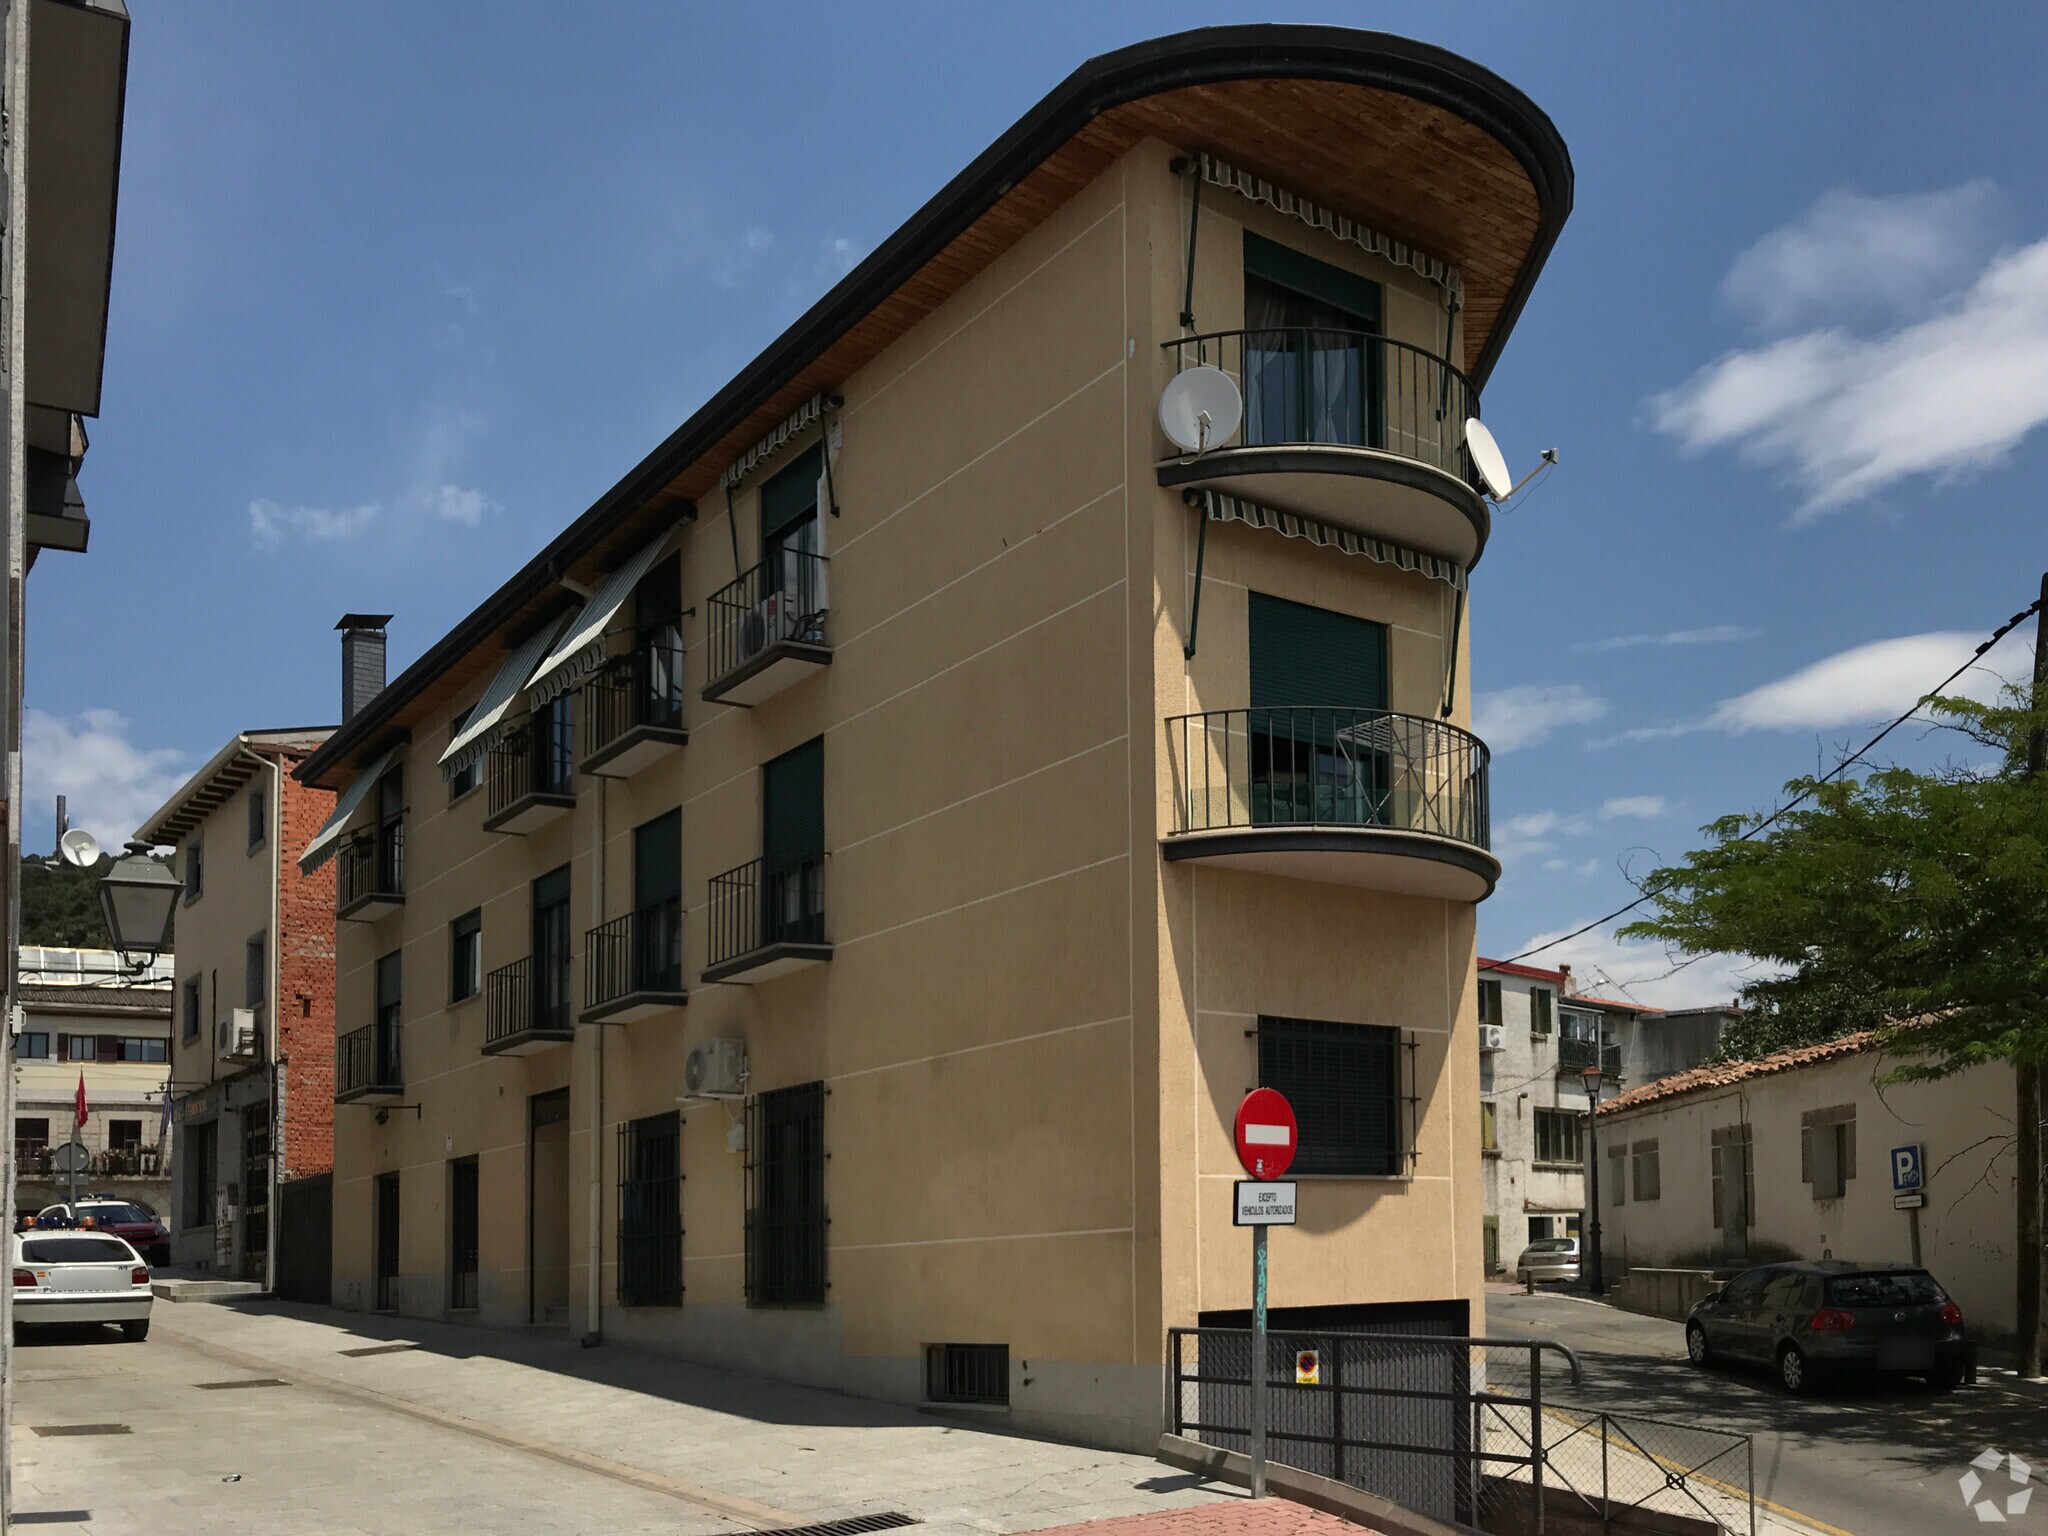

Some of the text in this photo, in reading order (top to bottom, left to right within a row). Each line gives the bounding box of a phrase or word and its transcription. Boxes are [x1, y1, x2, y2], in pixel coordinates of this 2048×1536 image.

[1896, 1151, 1914, 1185] P
[1258, 1192, 1277, 1202] EXCEPTO
[1242, 1204, 1293, 1216] VEHICULOS AUTORIZADOS
